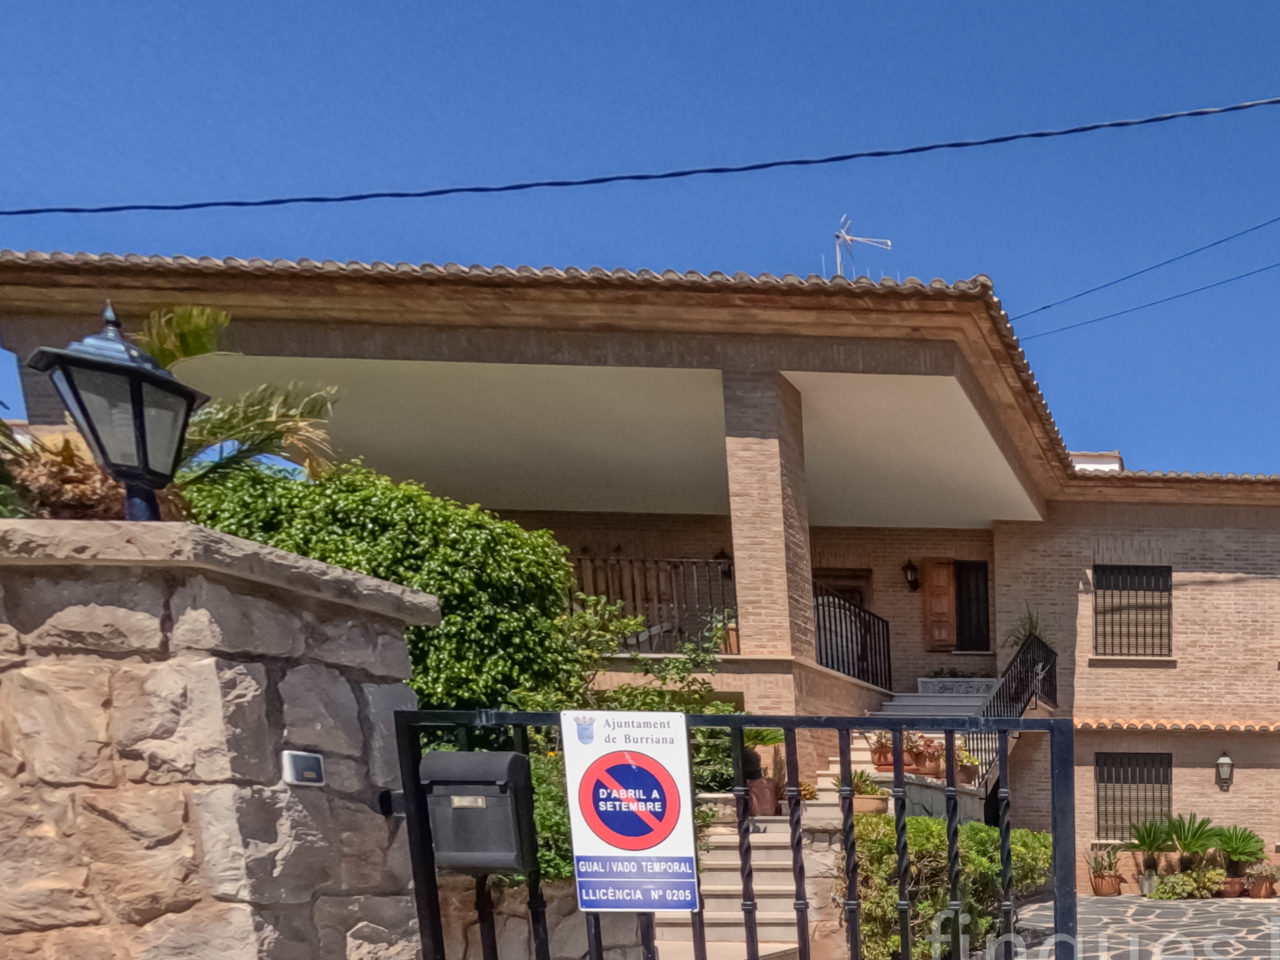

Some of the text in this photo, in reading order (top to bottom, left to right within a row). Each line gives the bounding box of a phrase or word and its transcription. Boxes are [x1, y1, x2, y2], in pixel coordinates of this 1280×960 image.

[603, 718, 671, 730] Ajuntament
[604, 734, 675, 745] de Burriana
[599, 788, 660, 799] D'ABRIL A
[598, 801, 662, 811] SETEMBRE
[579, 861, 604, 872] GUAL
[611, 862, 637, 872] VADO
[641, 862, 692, 873] TEMPORAL
[582, 887, 691, 900] LLICÈNCIA Nº 0205
